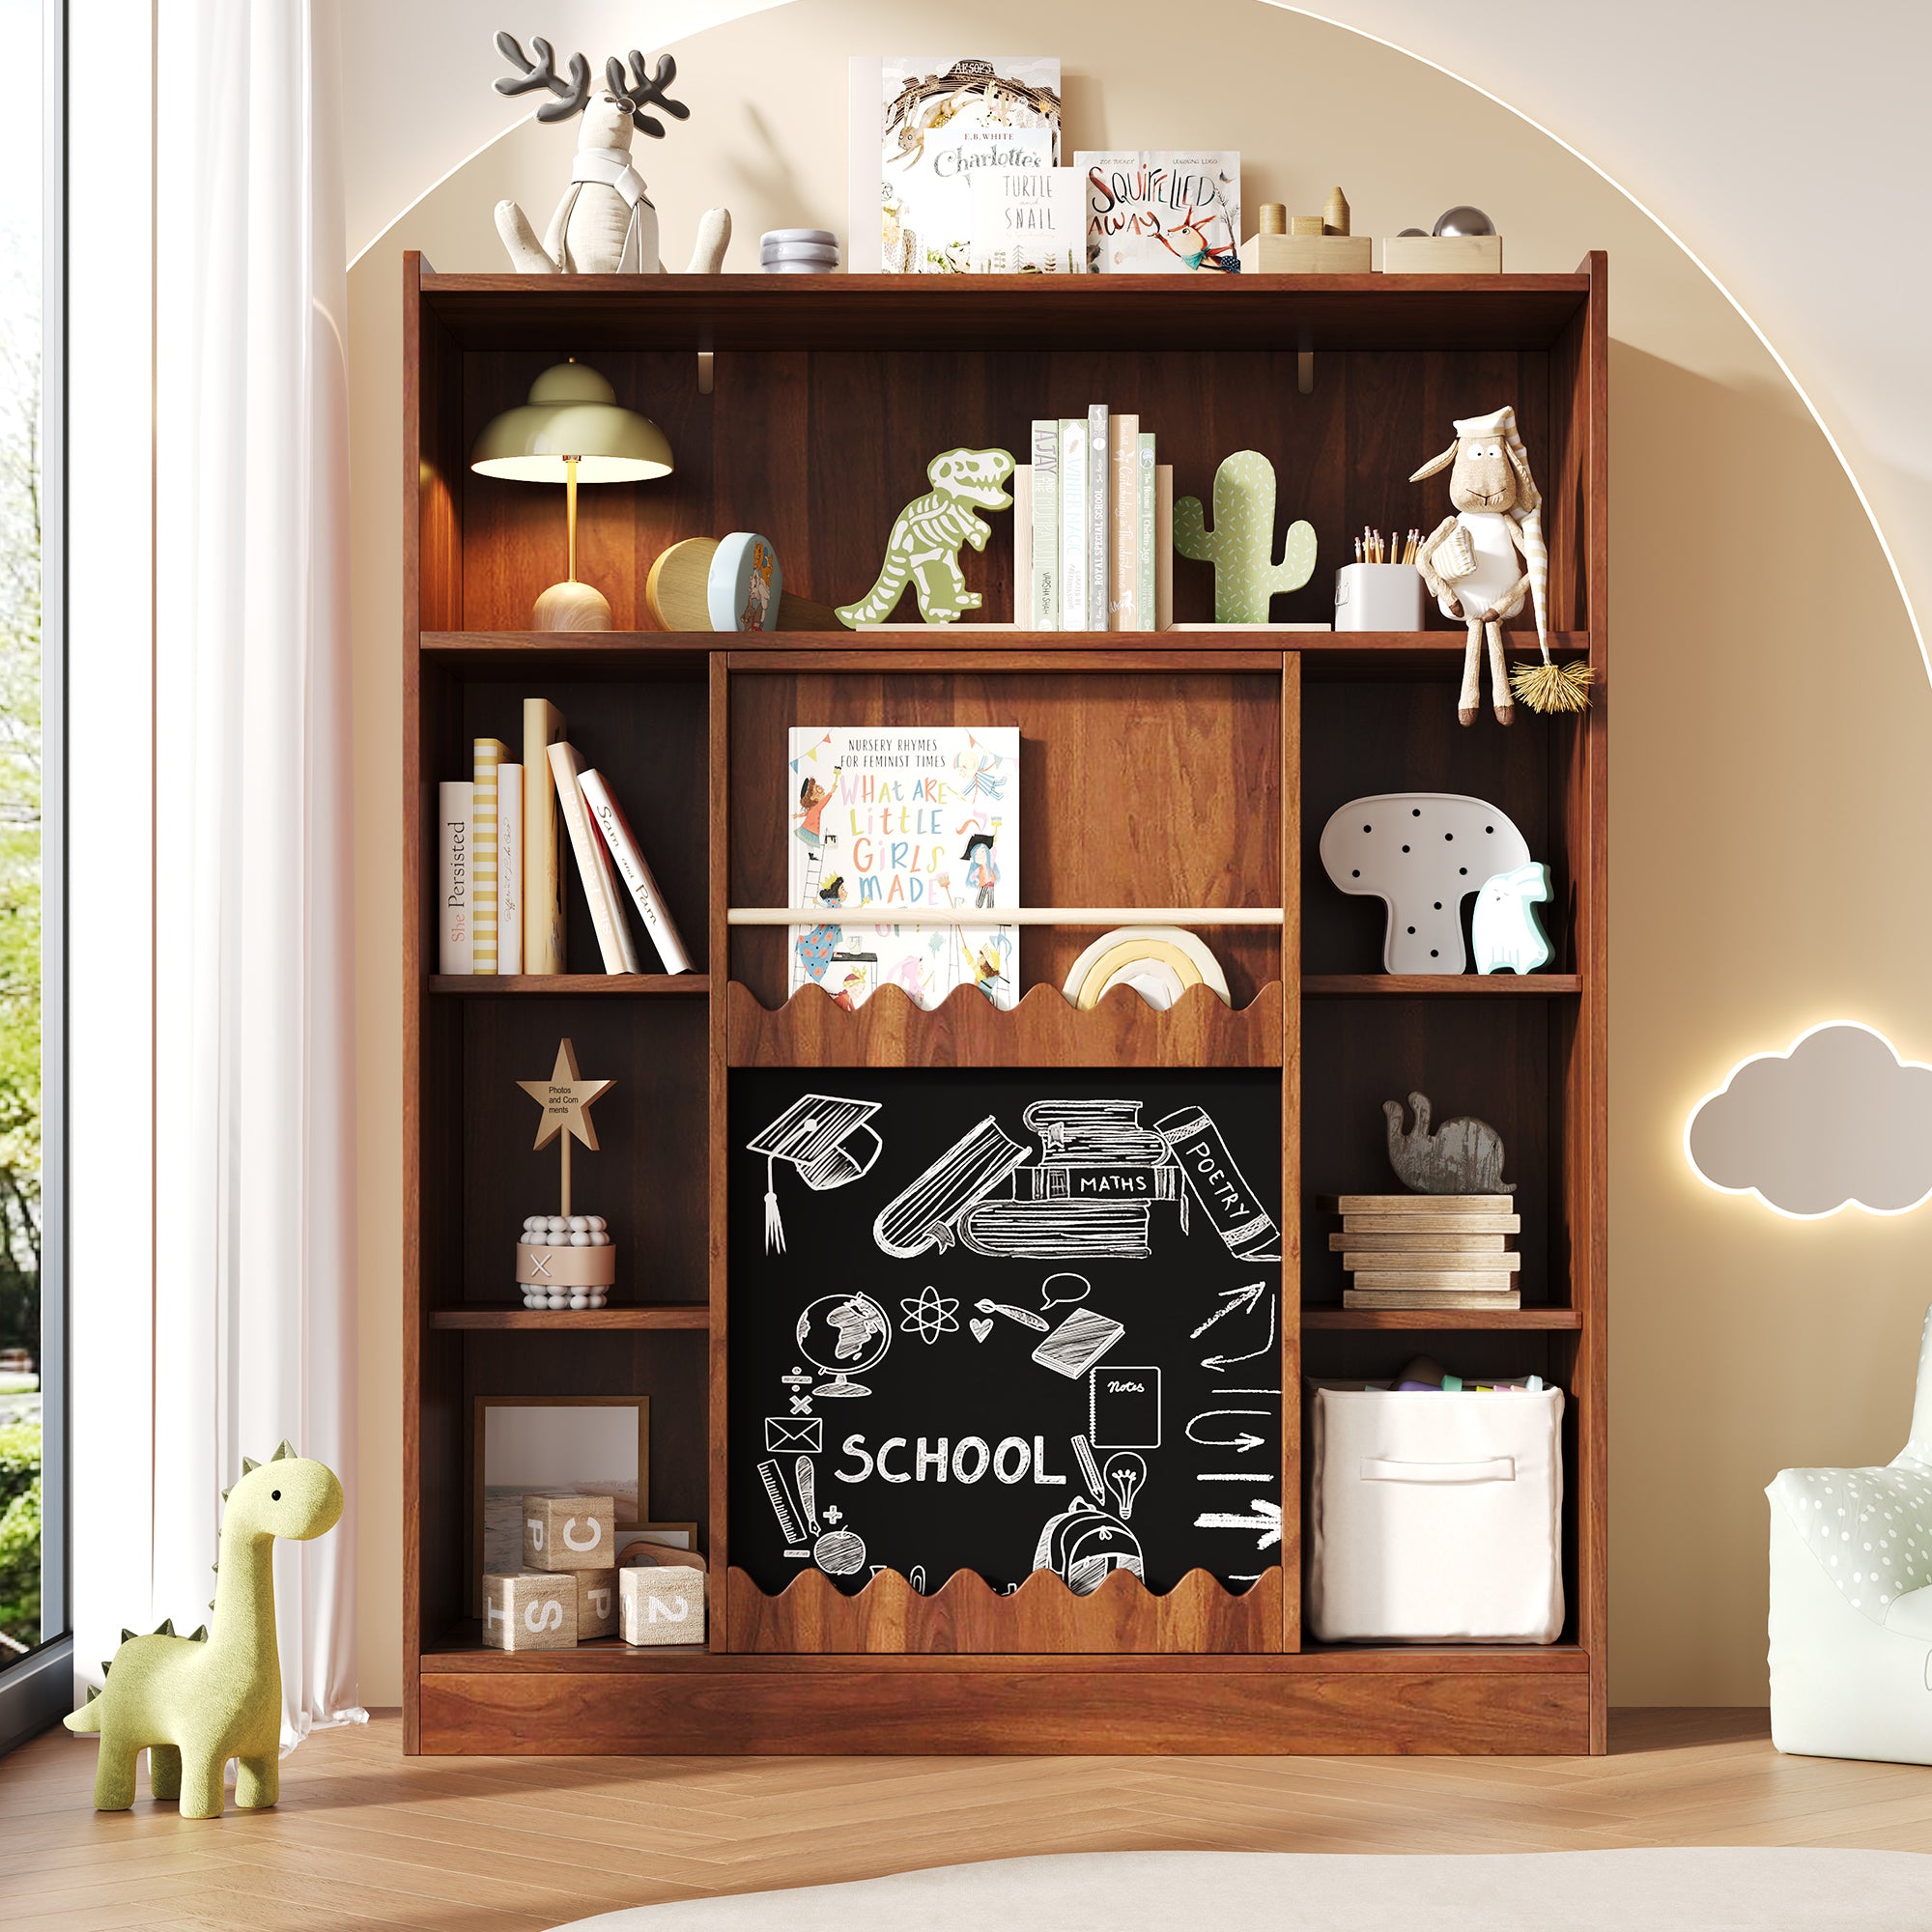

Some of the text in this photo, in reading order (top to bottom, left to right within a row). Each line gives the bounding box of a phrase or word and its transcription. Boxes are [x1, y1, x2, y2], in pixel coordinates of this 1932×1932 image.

[933, 144, 1041, 178] Charlotte's
[1006, 175, 1053, 197] TURTLE
[1005, 207, 1056, 230] SNAIL
[1034, 429, 1058, 475] AJAY
[1035, 476, 1045, 494] THE
[1044, 476, 1056, 494] AND
[1065, 457, 1083, 509] WINTER
[1094, 489, 1103, 520] SCHOOL
[1065, 512, 1083, 555] MAGIC
[1094, 522, 1103, 555] SPECIAL
[1094, 557, 1103, 585] ROYAL
[848, 739, 938, 752] NURSERY RHYMES
[840, 755, 946, 768] FOR FEMINIST TIMES
[912, 777, 950, 805] ARE
[597, 805, 619, 848] Sam
[636, 884, 657, 926] Pam
[447, 821, 466, 943] She Persisted
[548, 1086, 572, 1094] Photos
[548, 1095, 579, 1104] and Com
[1080, 1176, 1148, 1193] MATHS
[1186, 1141, 1250, 1221] POETRY
[1107, 1379, 1146, 1393] Notes
[834, 1434, 1067, 1486] SCHOOL
[562, 1516, 602, 1552] C
[525, 1599, 563, 1634] S
